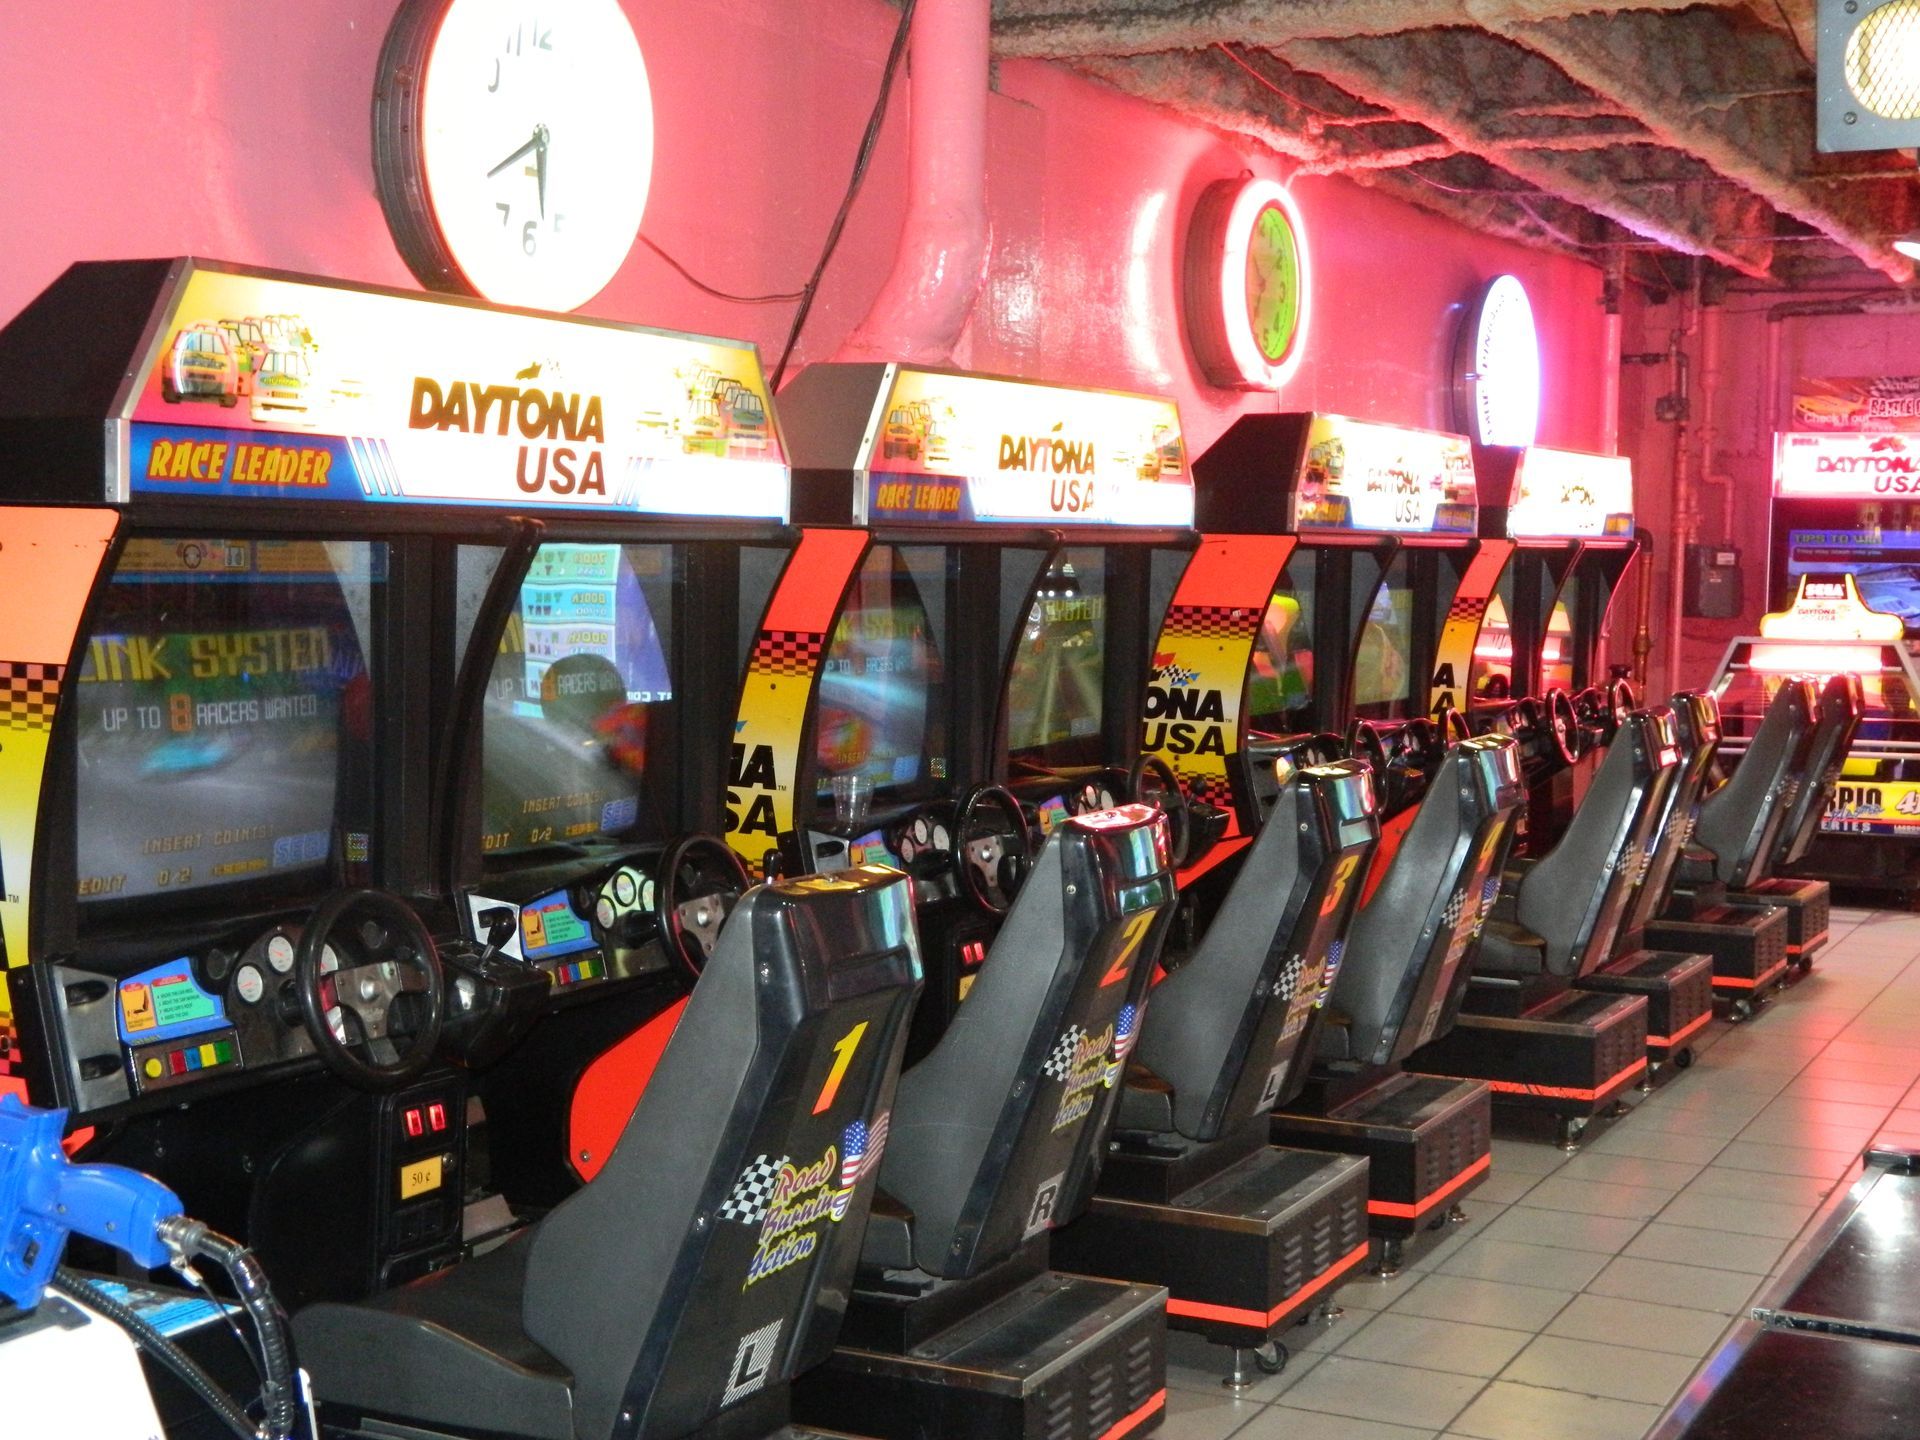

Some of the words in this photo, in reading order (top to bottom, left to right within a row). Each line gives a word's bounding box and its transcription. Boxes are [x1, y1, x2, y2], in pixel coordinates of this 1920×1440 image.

[522, 220, 538, 256] 6
[408, 376, 605, 443] DAYTONA
[148, 438, 228, 481] RACE
[230, 443, 332, 487] LEADER
[516, 446, 606, 496] USA
[998, 434, 1095, 475] DAYTONA
[876, 483, 913, 511] RACE
[913, 485, 962, 513] LEADER
[1049, 479, 1094, 512] USA
[1395, 499, 1421, 523] USA
[103, 707, 128, 731] UP
[137, 706, 161, 730] TO
[169, 693, 193, 732] 8
[196, 701, 259, 726] RACERS
[265, 694, 317, 721] WANTED
[1142, 722, 1225, 757] USA
[142, 833, 201, 855] INSERT
[481, 832, 511, 850] DIT
[1320, 855, 1360, 916] 3
[1100, 910, 1157, 988] 2
[812, 1021, 868, 1115] 1
[411, 1171, 423, 1187] 50
[774, 1145, 837, 1203] Road
[759, 1185, 855, 1246] Burning
[1030, 1183, 1058, 1229] R
[744, 1232, 816, 1291] Action
[732, 1339, 764, 1391] L
